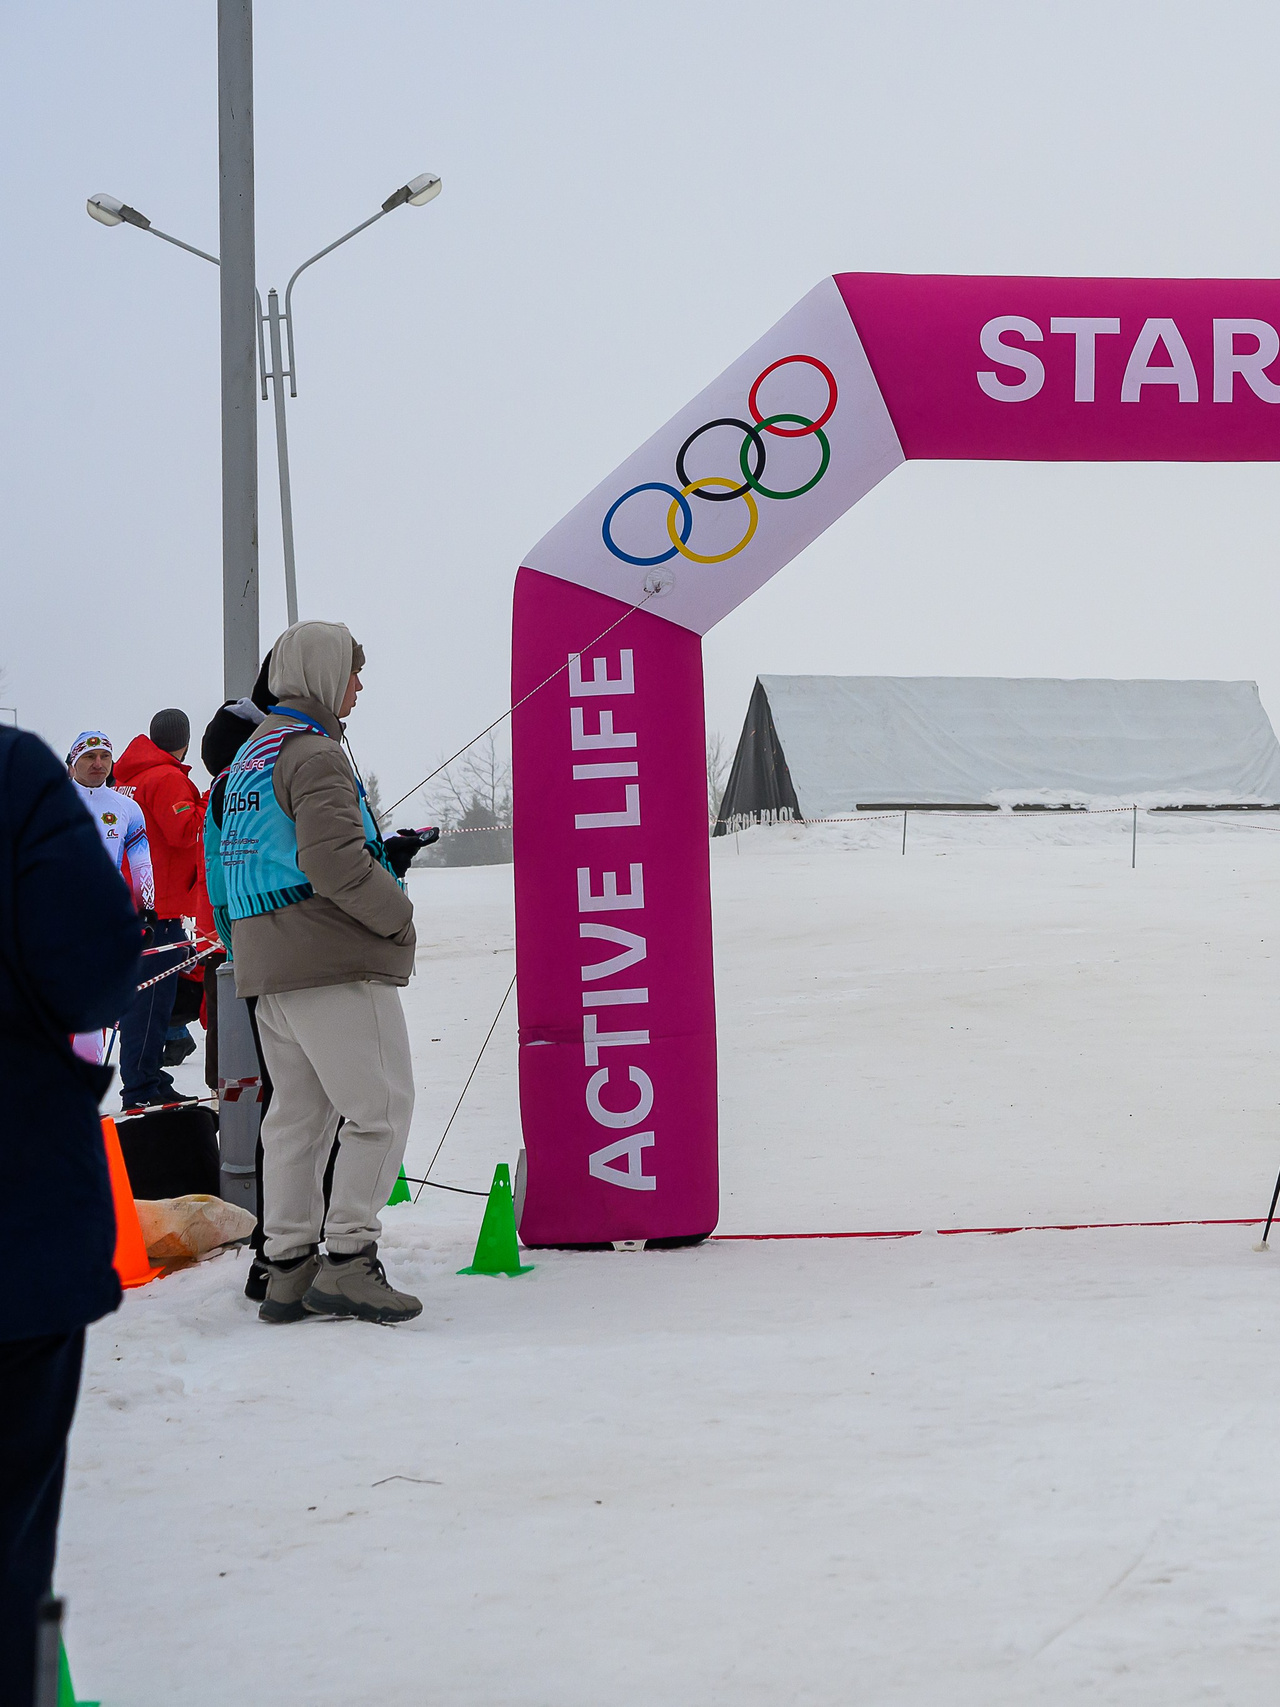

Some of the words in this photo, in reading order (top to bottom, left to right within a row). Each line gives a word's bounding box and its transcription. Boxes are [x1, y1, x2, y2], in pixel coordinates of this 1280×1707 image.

[223, 791, 260, 816] УДЬЯ
[568, 649, 640, 829] LIFE
[577, 863, 656, 1191] ACTIVE
